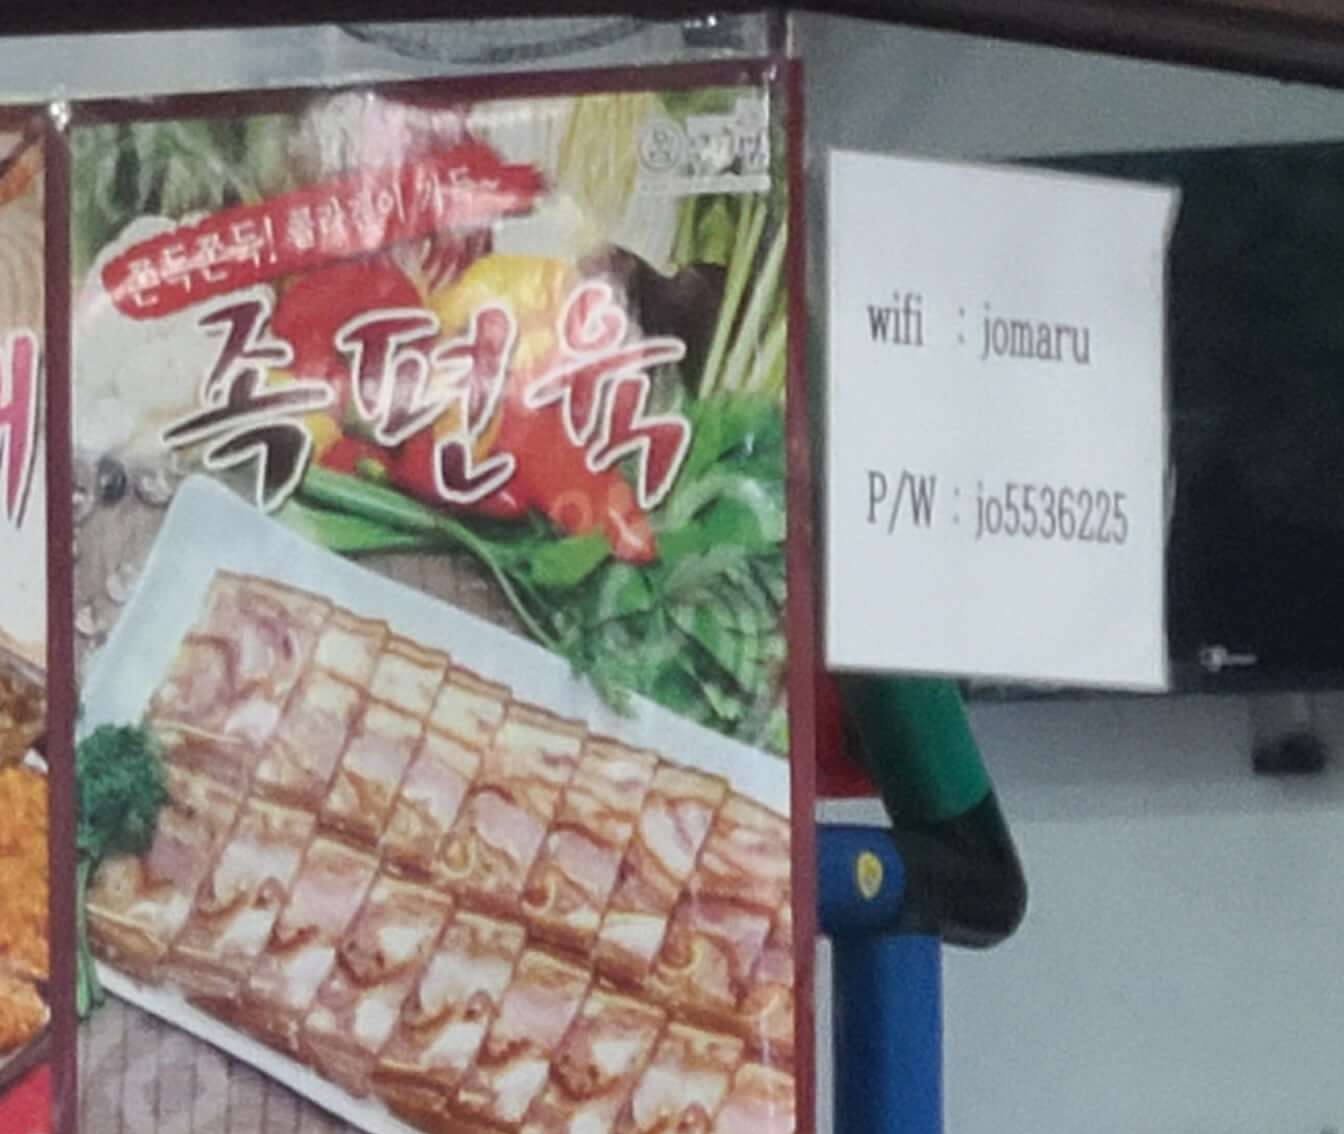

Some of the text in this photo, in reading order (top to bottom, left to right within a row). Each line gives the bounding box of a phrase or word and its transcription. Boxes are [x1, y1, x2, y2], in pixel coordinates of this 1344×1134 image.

[866, 292, 924, 347] wifi
[980, 303, 1092, 365] jomaru
[866, 469, 938, 536] P/W
[974, 481, 1130, 545] jo5536225
